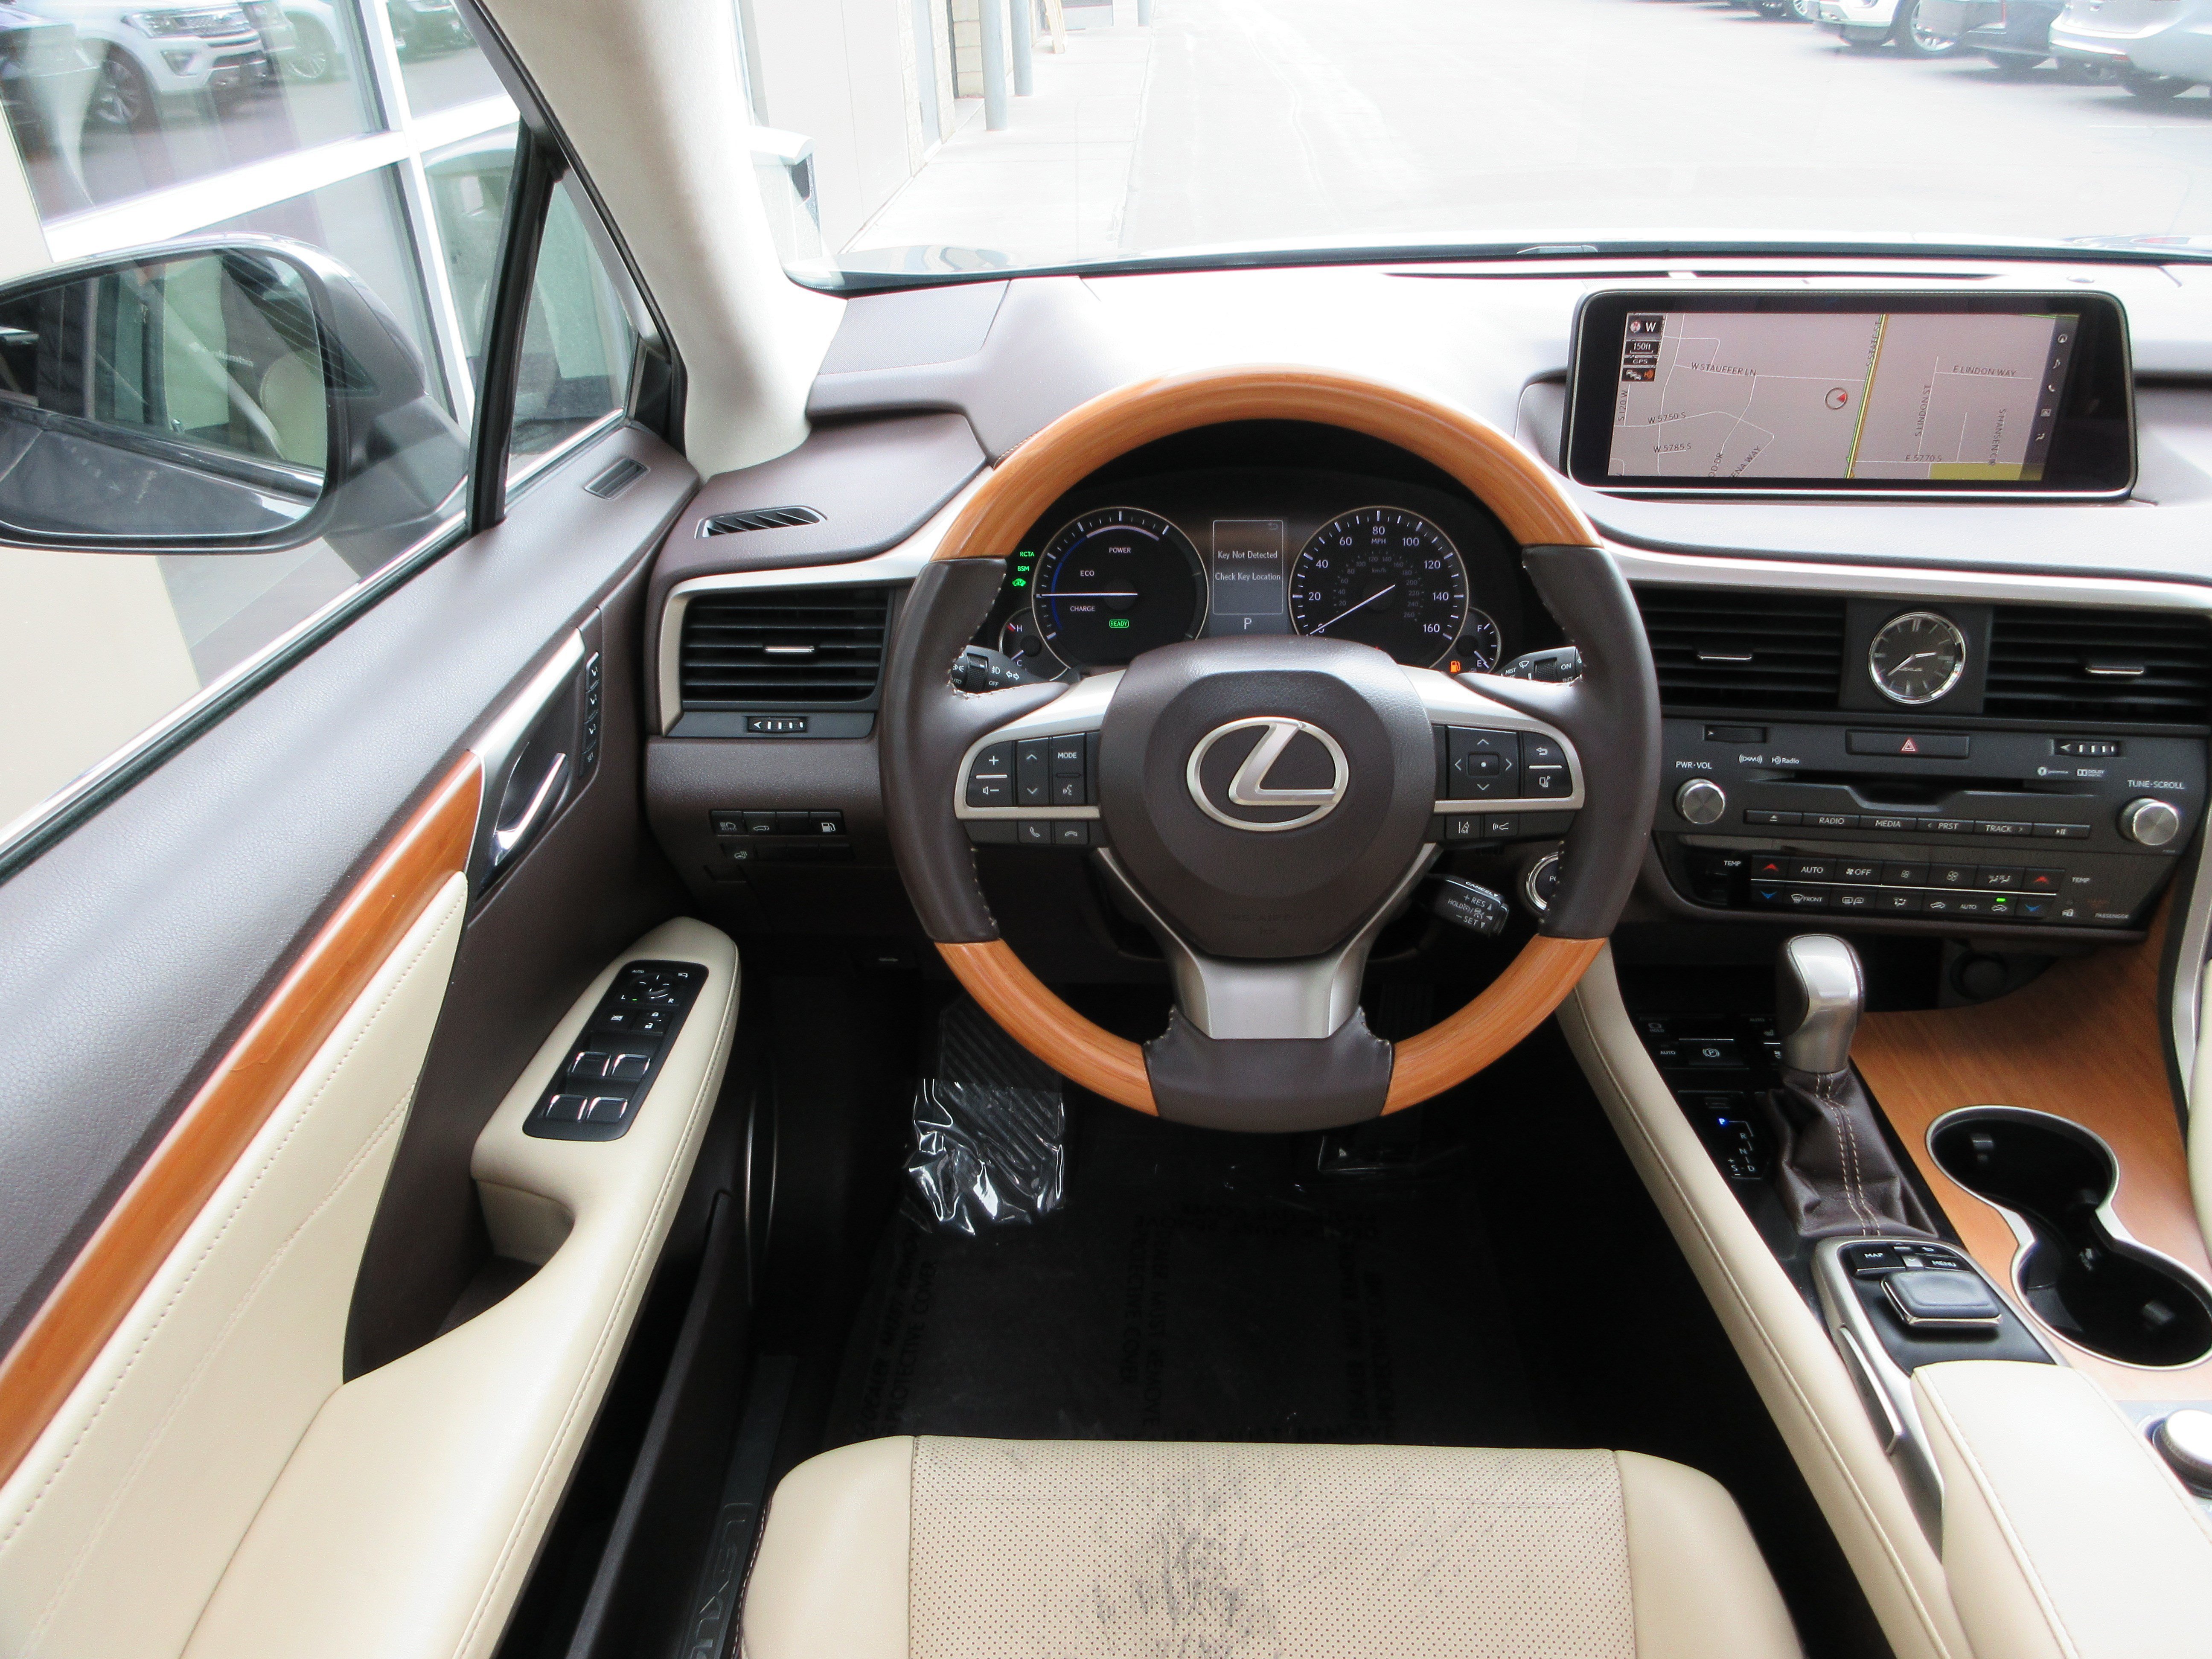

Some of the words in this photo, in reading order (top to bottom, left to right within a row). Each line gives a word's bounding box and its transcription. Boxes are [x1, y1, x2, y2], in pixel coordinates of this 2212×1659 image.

[1646, 322, 1656, 332] W
[1873, 320, 1881, 331] ST
[1700, 364, 1743, 374] STAUFFER
[1961, 366, 1994, 375] LINDON
[1916, 397, 1929, 429] LINDON
[1923, 384, 1931, 394] ST
[1658, 413, 1678, 422] 5750
[1991, 416, 2004, 450] HANSEN
[1714, 452, 1723, 464] DR
[1743, 445, 1761, 462] WAY
[1372, 526, 1385, 535] 80
[1339, 537, 1352, 546] 60
[1402, 538, 1419, 546] 100
[1218, 551, 1230, 559] Key
[1232, 550, 1245, 559] Not
[1247, 550, 1278, 559] Detected
[1316, 559, 1328, 568] 40
[1424, 560, 1441, 569] 120
[1215, 572, 1236, 580] Check
[1238, 572, 1250, 581] Key
[1252, 572, 1281, 580] Location
[1308, 592, 1321, 601] 20
[1432, 592, 1449, 601] 140
[1244, 618, 1252, 629] P
[1423, 623, 1440, 632] 160
[1875, 820, 1901, 828] MEDIA
[1985, 824, 2012, 833] TRACK
[1800, 866, 1824, 874] AUTO
[1465, 881, 1493, 896] CANCEL
[1447, 898, 1464, 909] HOLD
